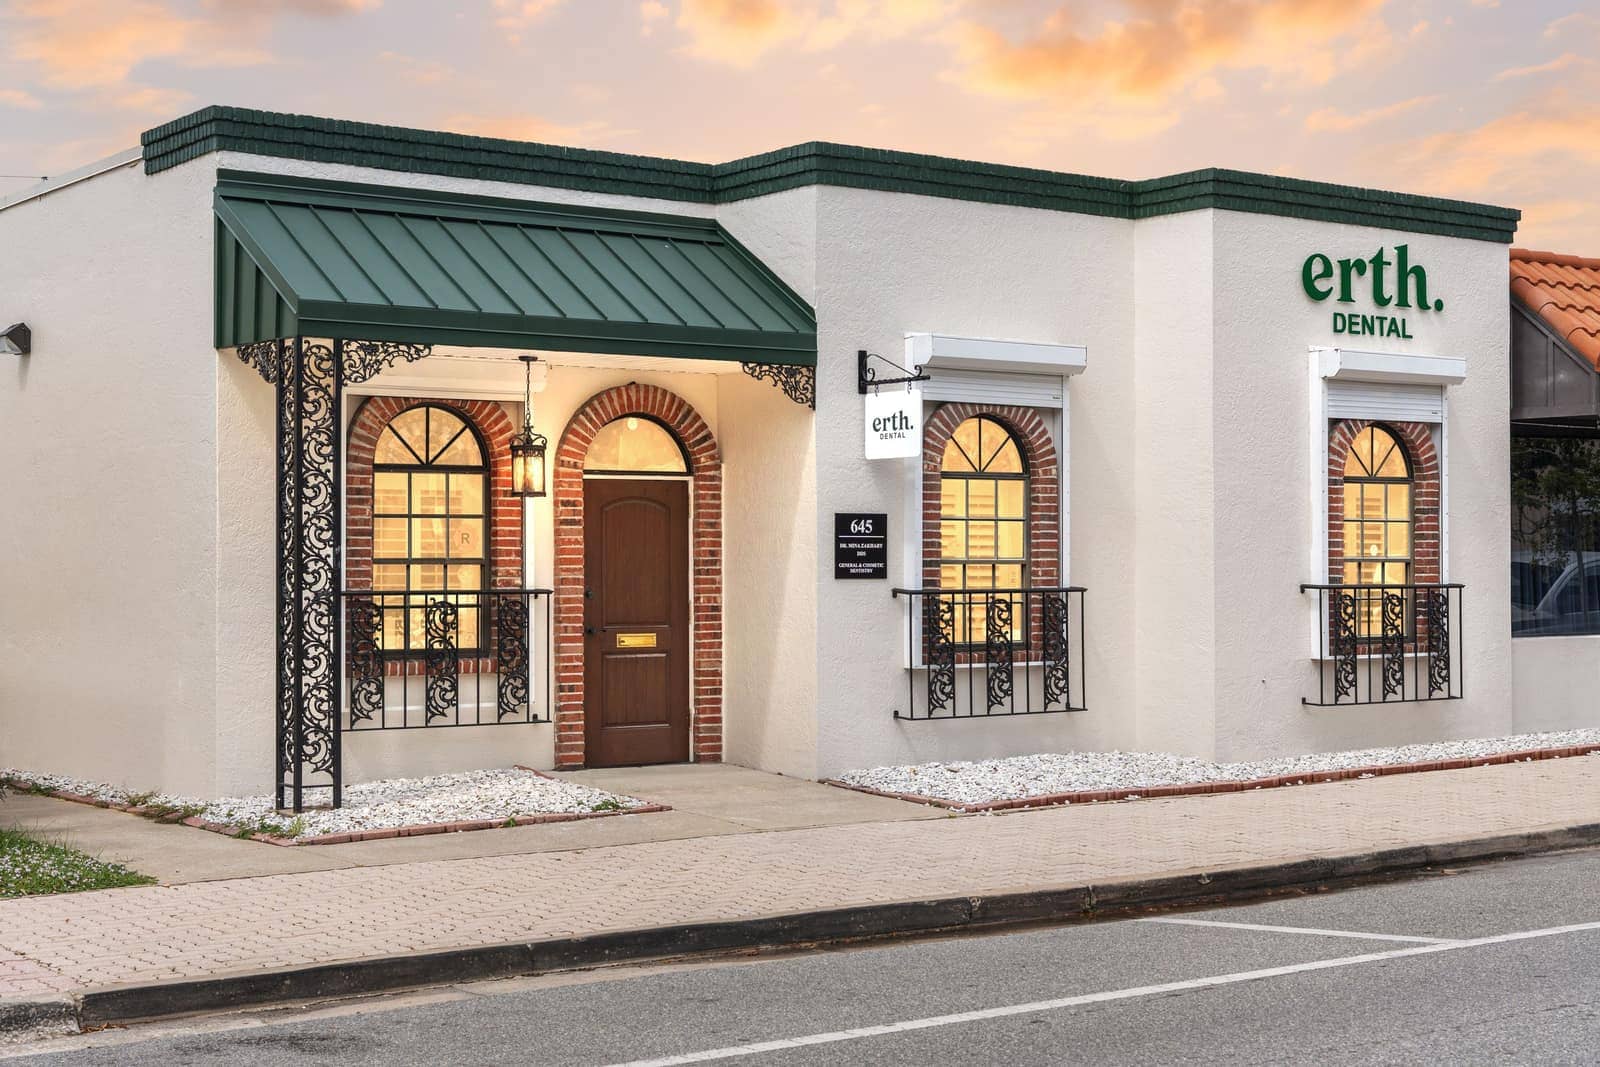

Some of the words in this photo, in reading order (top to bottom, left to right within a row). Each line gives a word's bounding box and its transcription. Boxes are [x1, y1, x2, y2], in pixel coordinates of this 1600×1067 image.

[1302, 244, 1443, 311] erth.
[1333, 312, 1413, 338] DENTAL
[872, 410, 914, 432] erth.
[880, 432, 906, 440] DENTAL
[850, 519, 873, 533] 645
